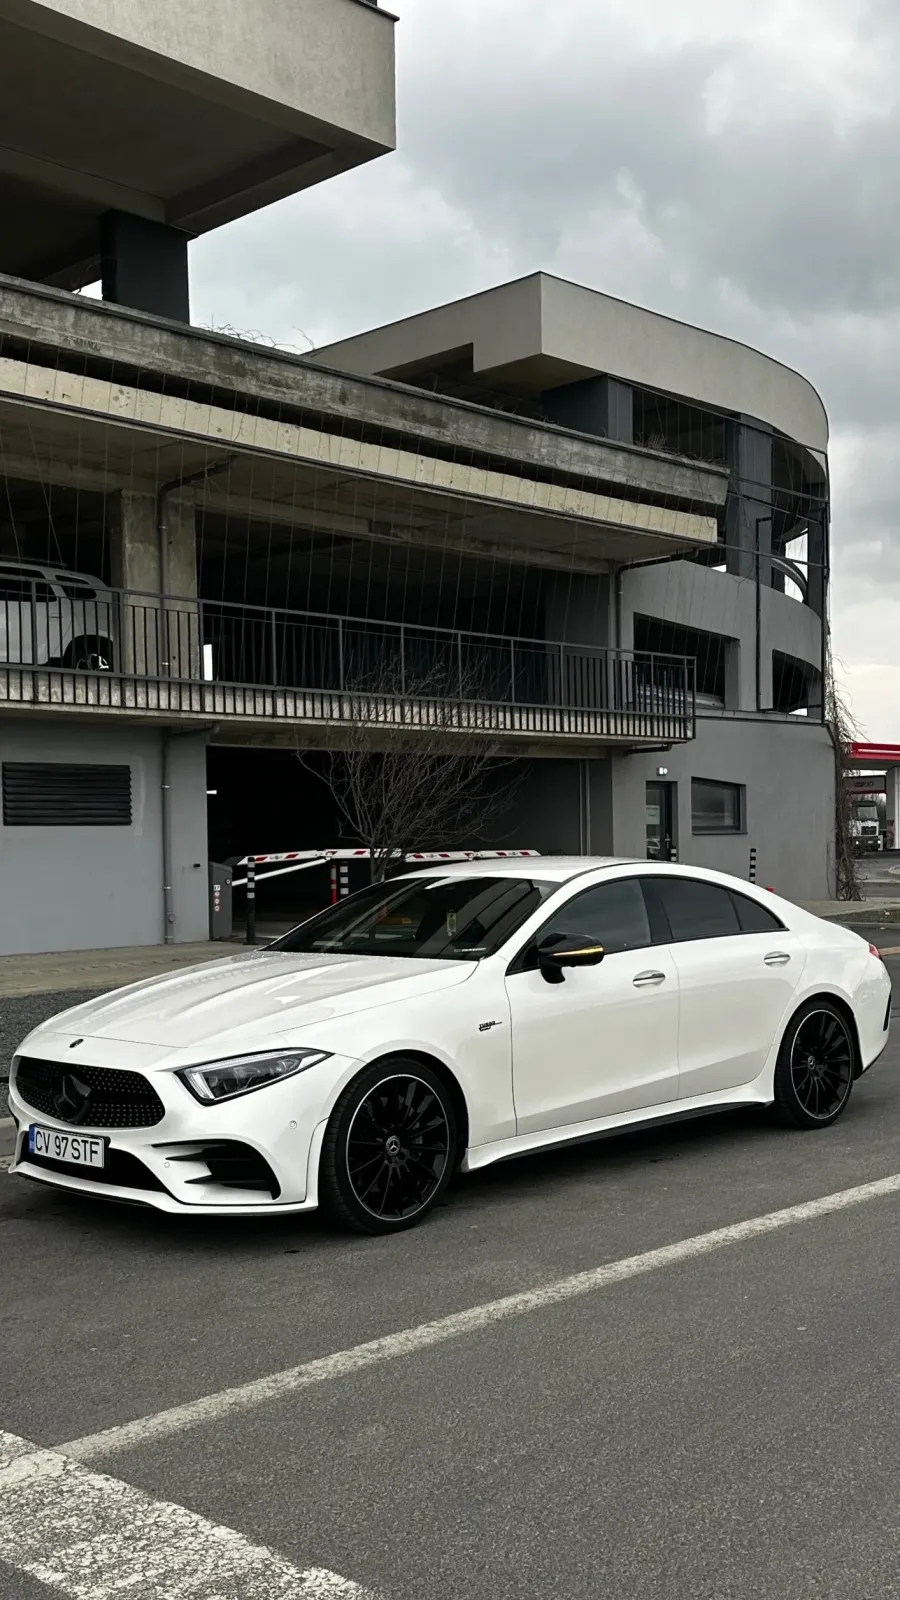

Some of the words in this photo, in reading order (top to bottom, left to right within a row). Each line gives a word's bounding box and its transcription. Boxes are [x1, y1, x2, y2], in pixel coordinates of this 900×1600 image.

[35, 1131, 50, 1153] CV
[54, 1135, 68, 1157] 97
[71, 1139, 99, 1162] STF
